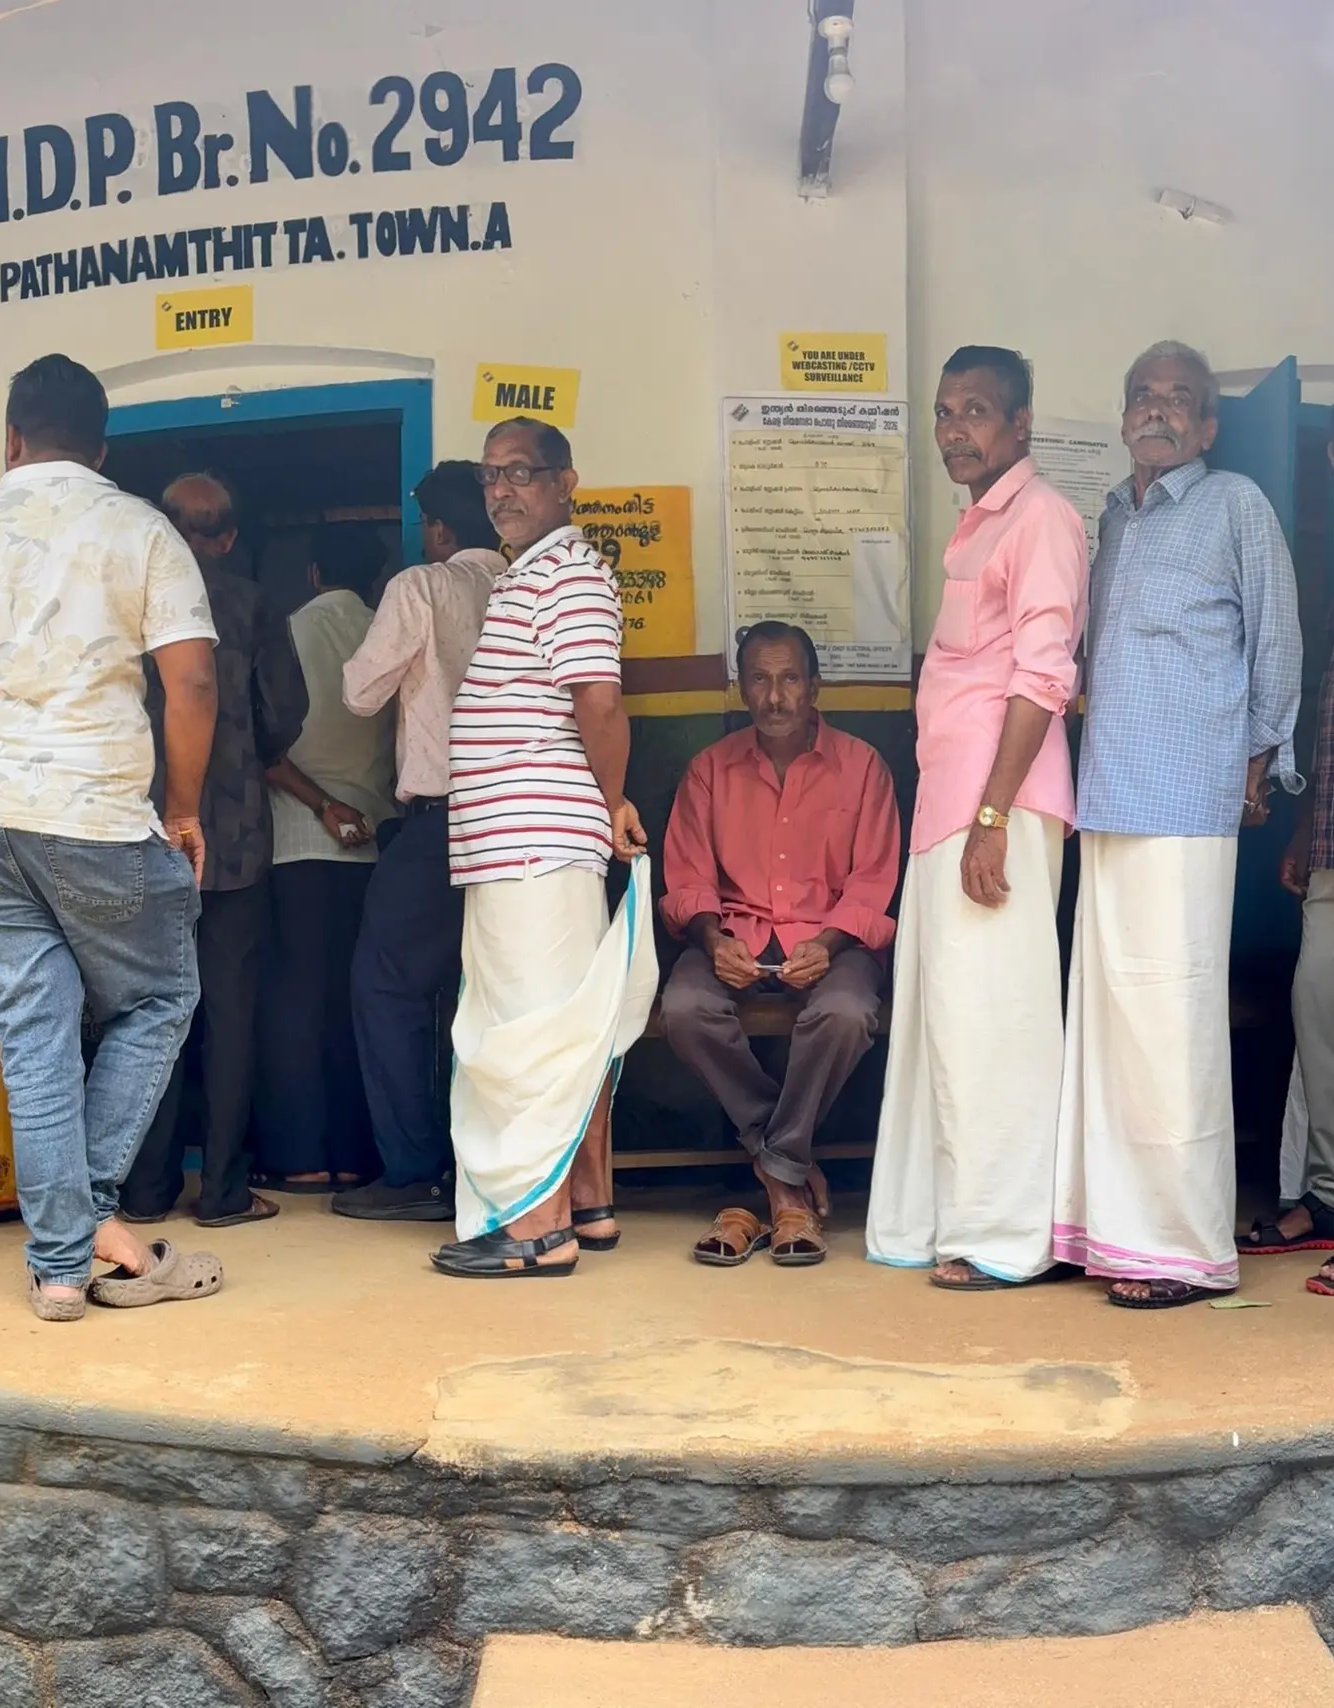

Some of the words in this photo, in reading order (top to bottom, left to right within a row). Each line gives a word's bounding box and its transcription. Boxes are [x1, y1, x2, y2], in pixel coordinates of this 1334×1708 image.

[175, 307, 233, 332] ENTRY
[801, 350, 819, 360] YOU
[820, 350, 837, 360] ARE
[837, 351, 865, 361] UNDER
[792, 361, 847, 371] WEBCASTING
[804, 372, 864, 383] SURVEILLANCE
[495, 382, 556, 411] MALE
